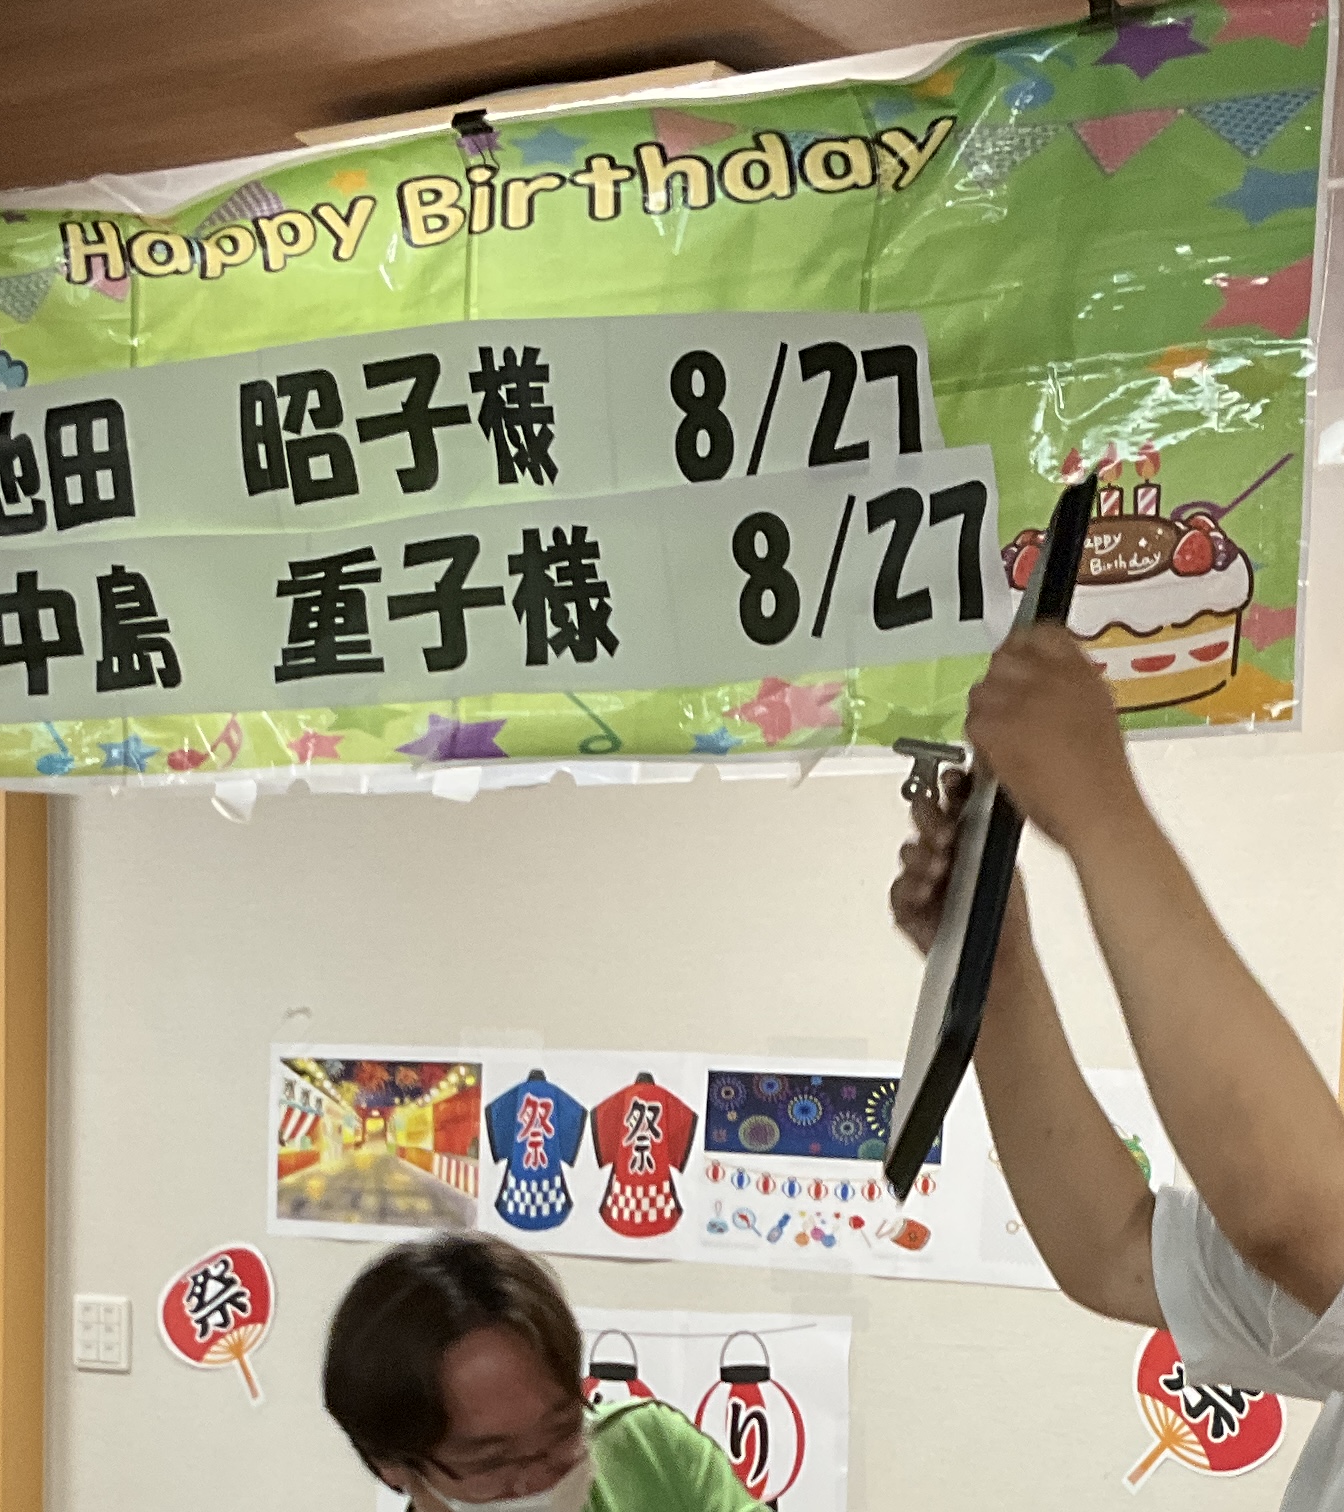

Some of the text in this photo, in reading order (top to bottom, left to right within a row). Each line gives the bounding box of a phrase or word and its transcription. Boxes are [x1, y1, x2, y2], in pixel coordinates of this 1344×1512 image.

[60, 115, 956, 284] Happy Birthday
[239, 346, 559, 504] 昭子様
[670, 341, 923, 483] 8/27
[274, 525, 620, 683] 重子様
[731, 479, 988, 646] 8/27
[1083, 533, 1123, 555] appy
[1089, 551, 1162, 577] Birthday
[518, 1094, 555, 1171] 祭
[625, 1099, 663, 1174] 祭
[185, 1258, 250, 1340] 祭
[730, 1401, 769, 1486] り
